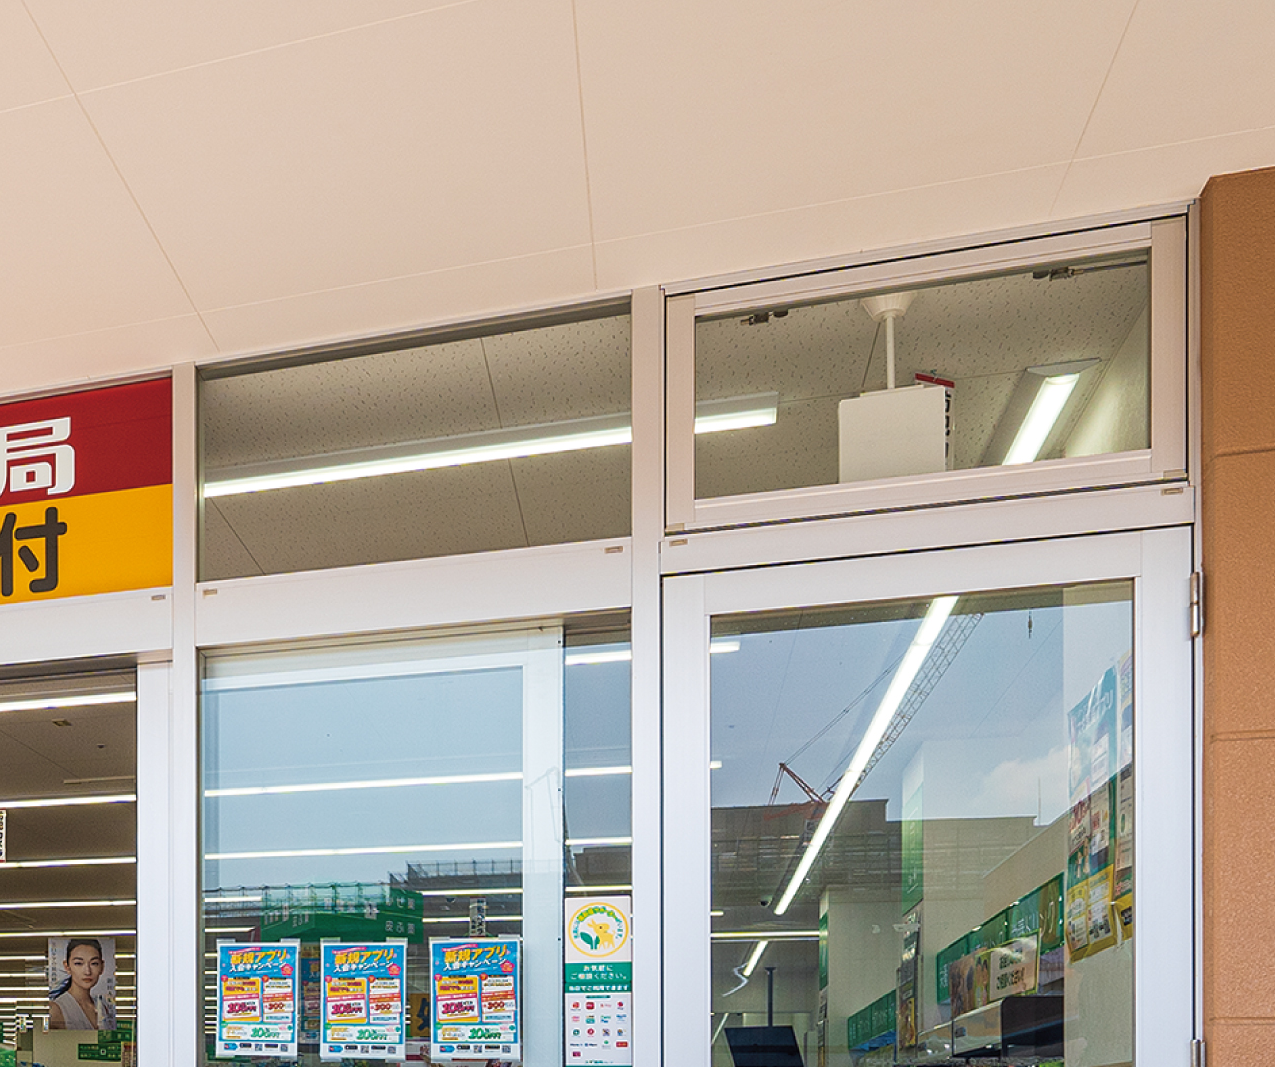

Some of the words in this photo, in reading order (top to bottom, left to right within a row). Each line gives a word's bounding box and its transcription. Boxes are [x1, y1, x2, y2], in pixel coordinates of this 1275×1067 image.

[231, 949, 287, 964] 新規アプリ
[335, 948, 394, 965] 新規アプリ
[444, 944, 507, 963] 新規アプリ
